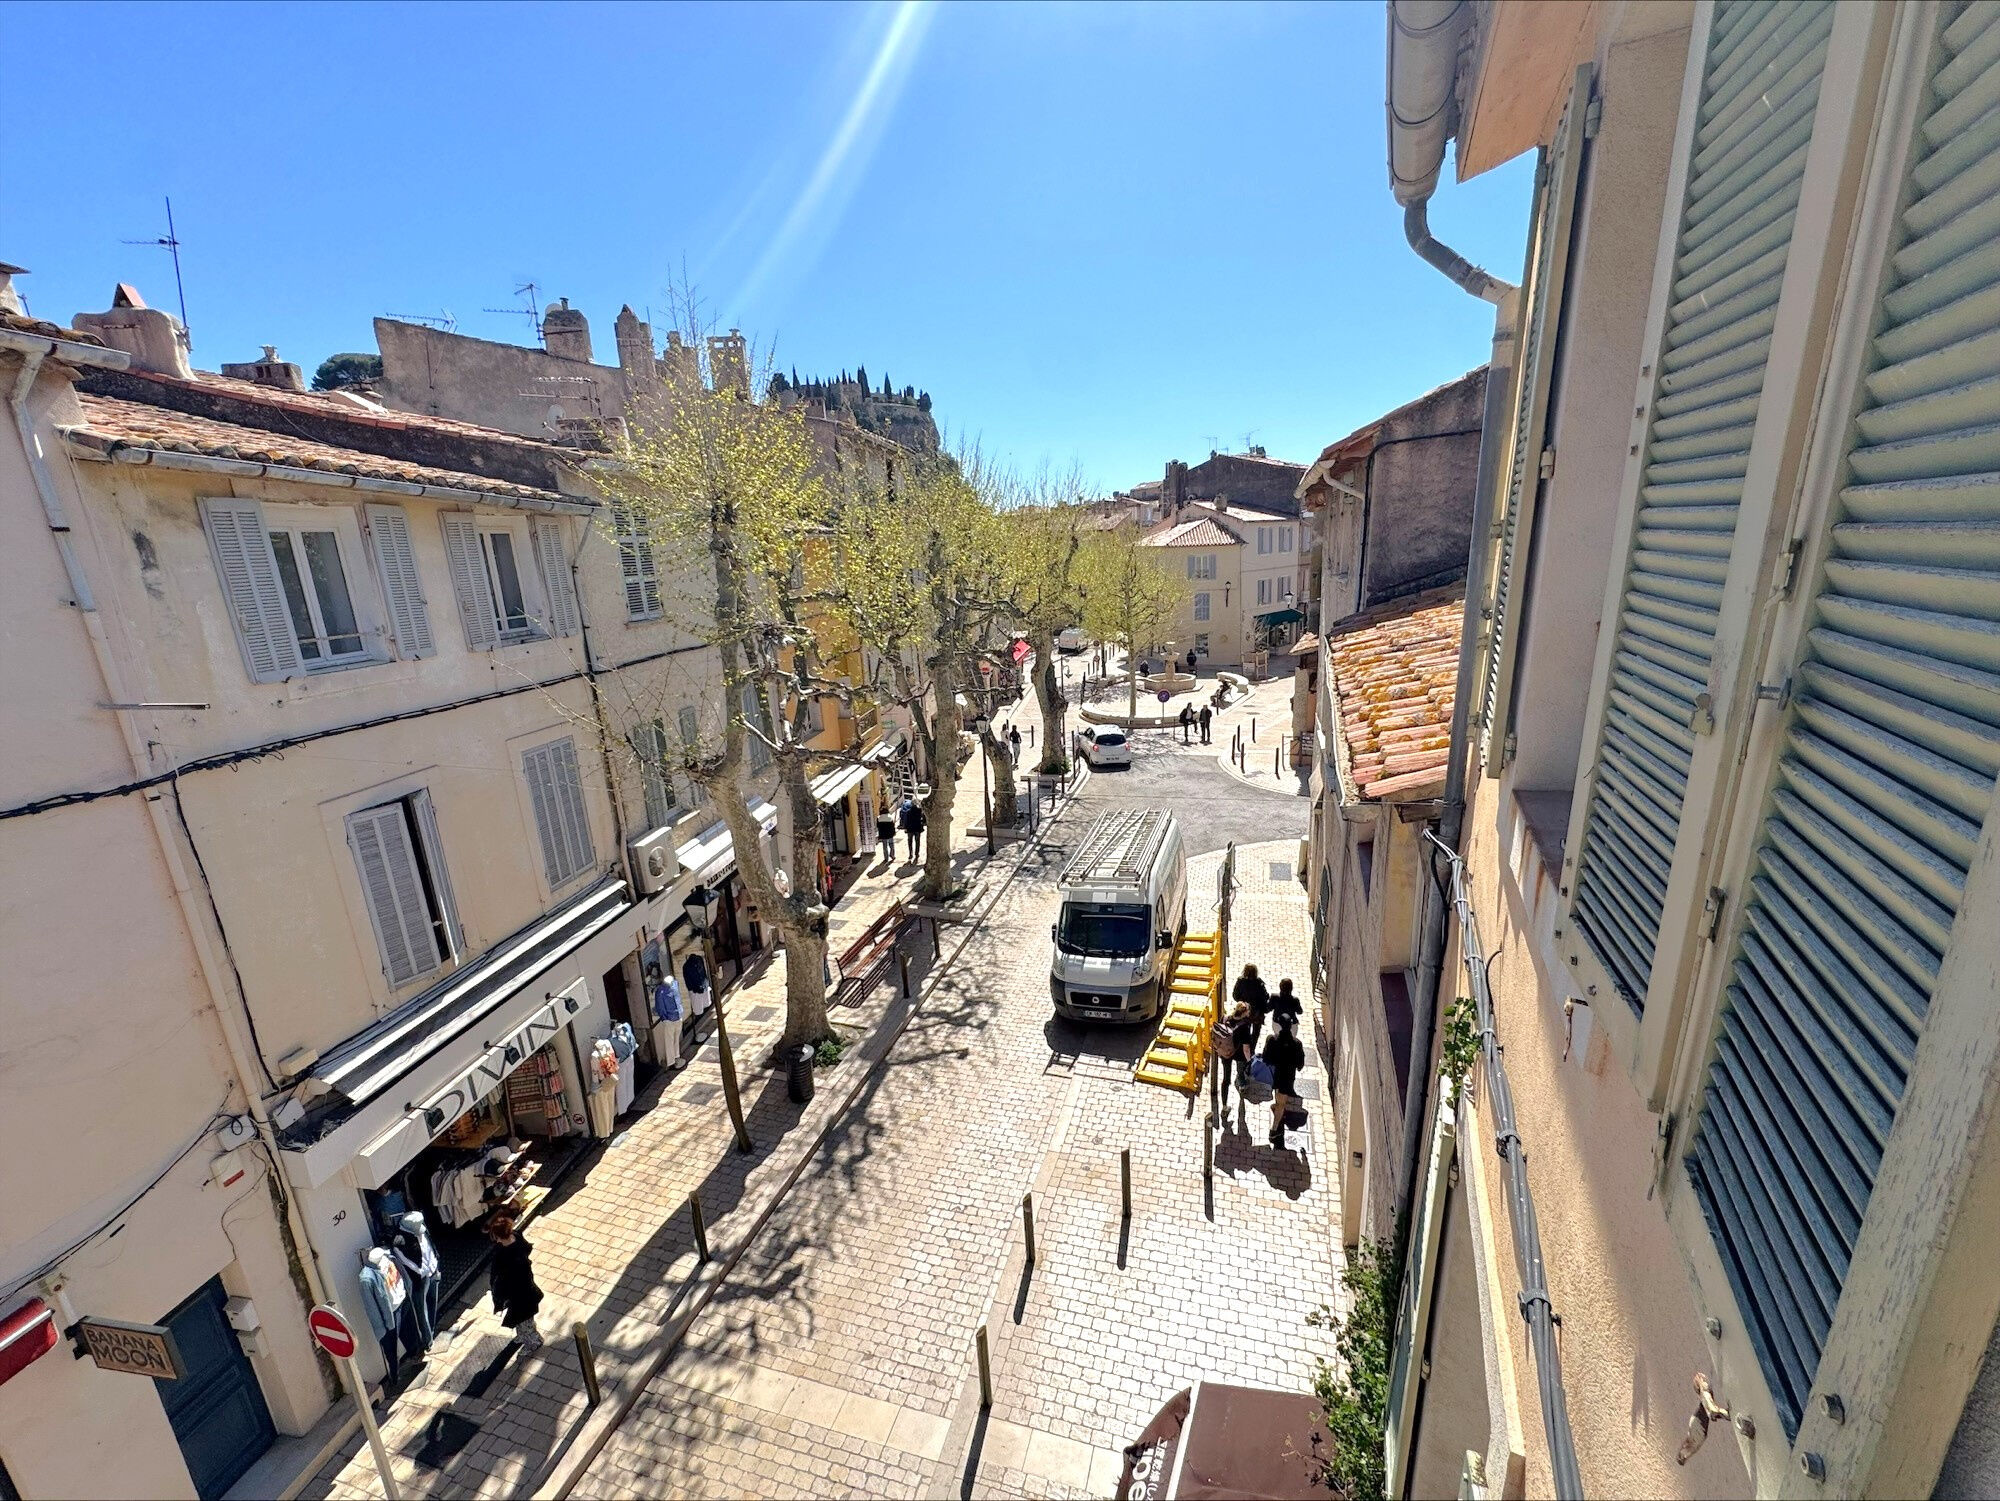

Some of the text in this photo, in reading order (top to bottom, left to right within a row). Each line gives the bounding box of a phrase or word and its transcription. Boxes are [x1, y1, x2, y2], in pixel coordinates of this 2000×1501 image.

[424, 1005, 560, 1139] DIVIN
[332, 1210, 347, 1226] 30
[86, 1329, 159, 1353] BANANA
[92, 1343, 168, 1372] MOON
